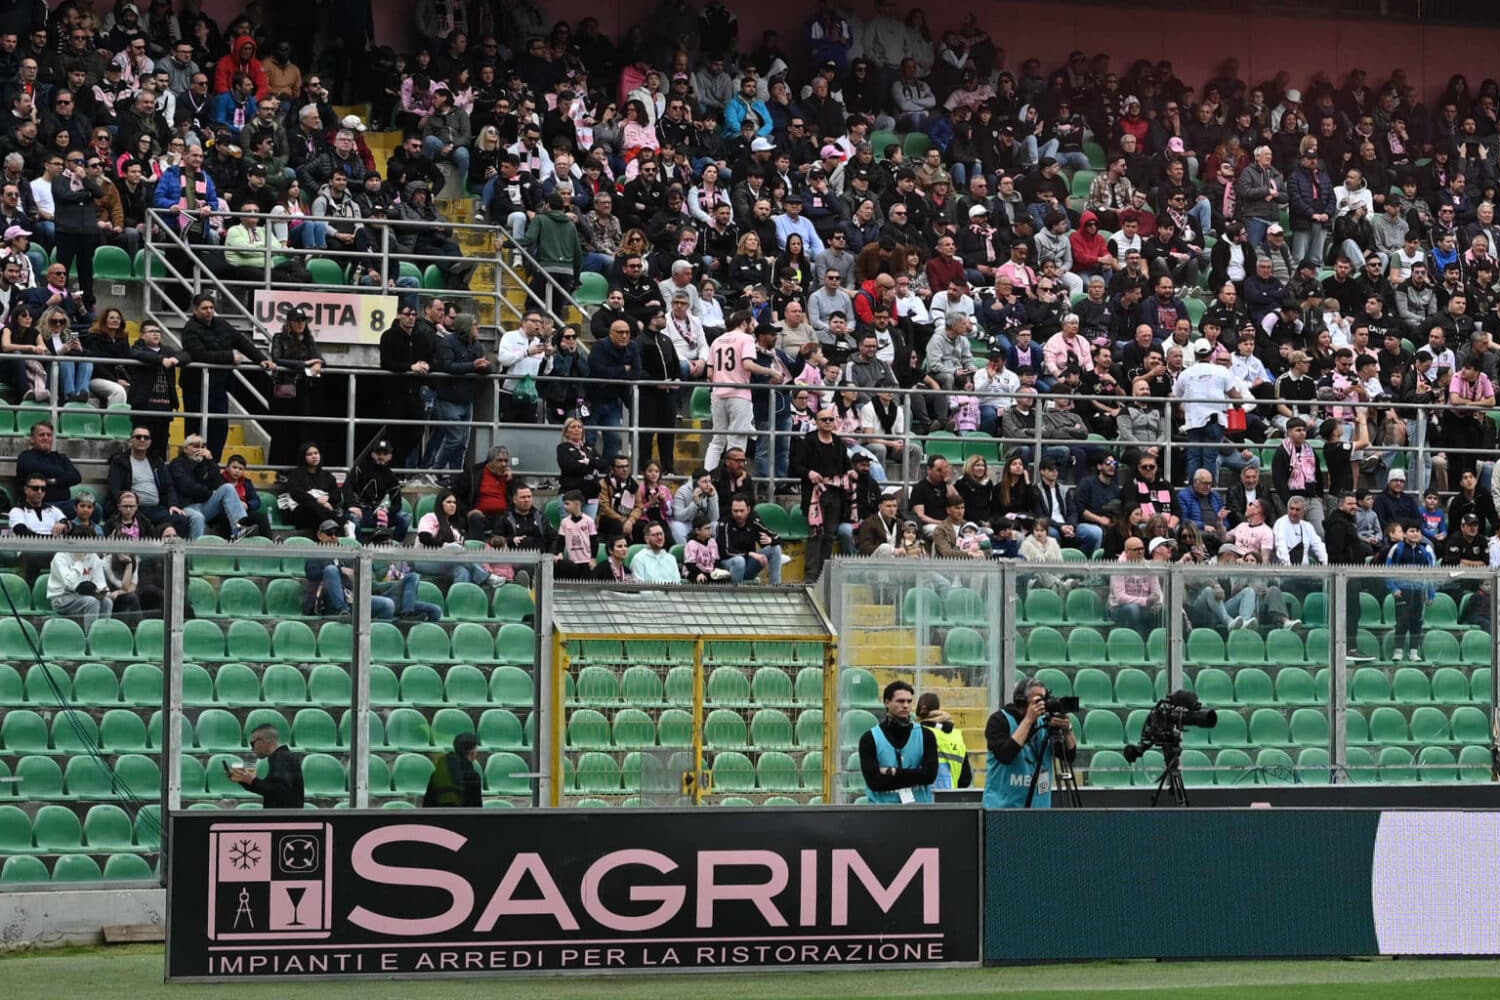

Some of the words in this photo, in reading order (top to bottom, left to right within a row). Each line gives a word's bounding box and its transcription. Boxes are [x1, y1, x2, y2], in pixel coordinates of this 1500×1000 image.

[256, 301, 358, 327] USCITA
[370, 309, 386, 332] 8
[715, 347, 736, 372] 13
[208, 953, 363, 975] IMPIANTI
[381, 953, 399, 971] E
[415, 950, 544, 970] ARREDI
[561, 948, 626, 966] PER
[643, 946, 680, 965] LA
[696, 943, 944, 964] RISTORAZIONE
